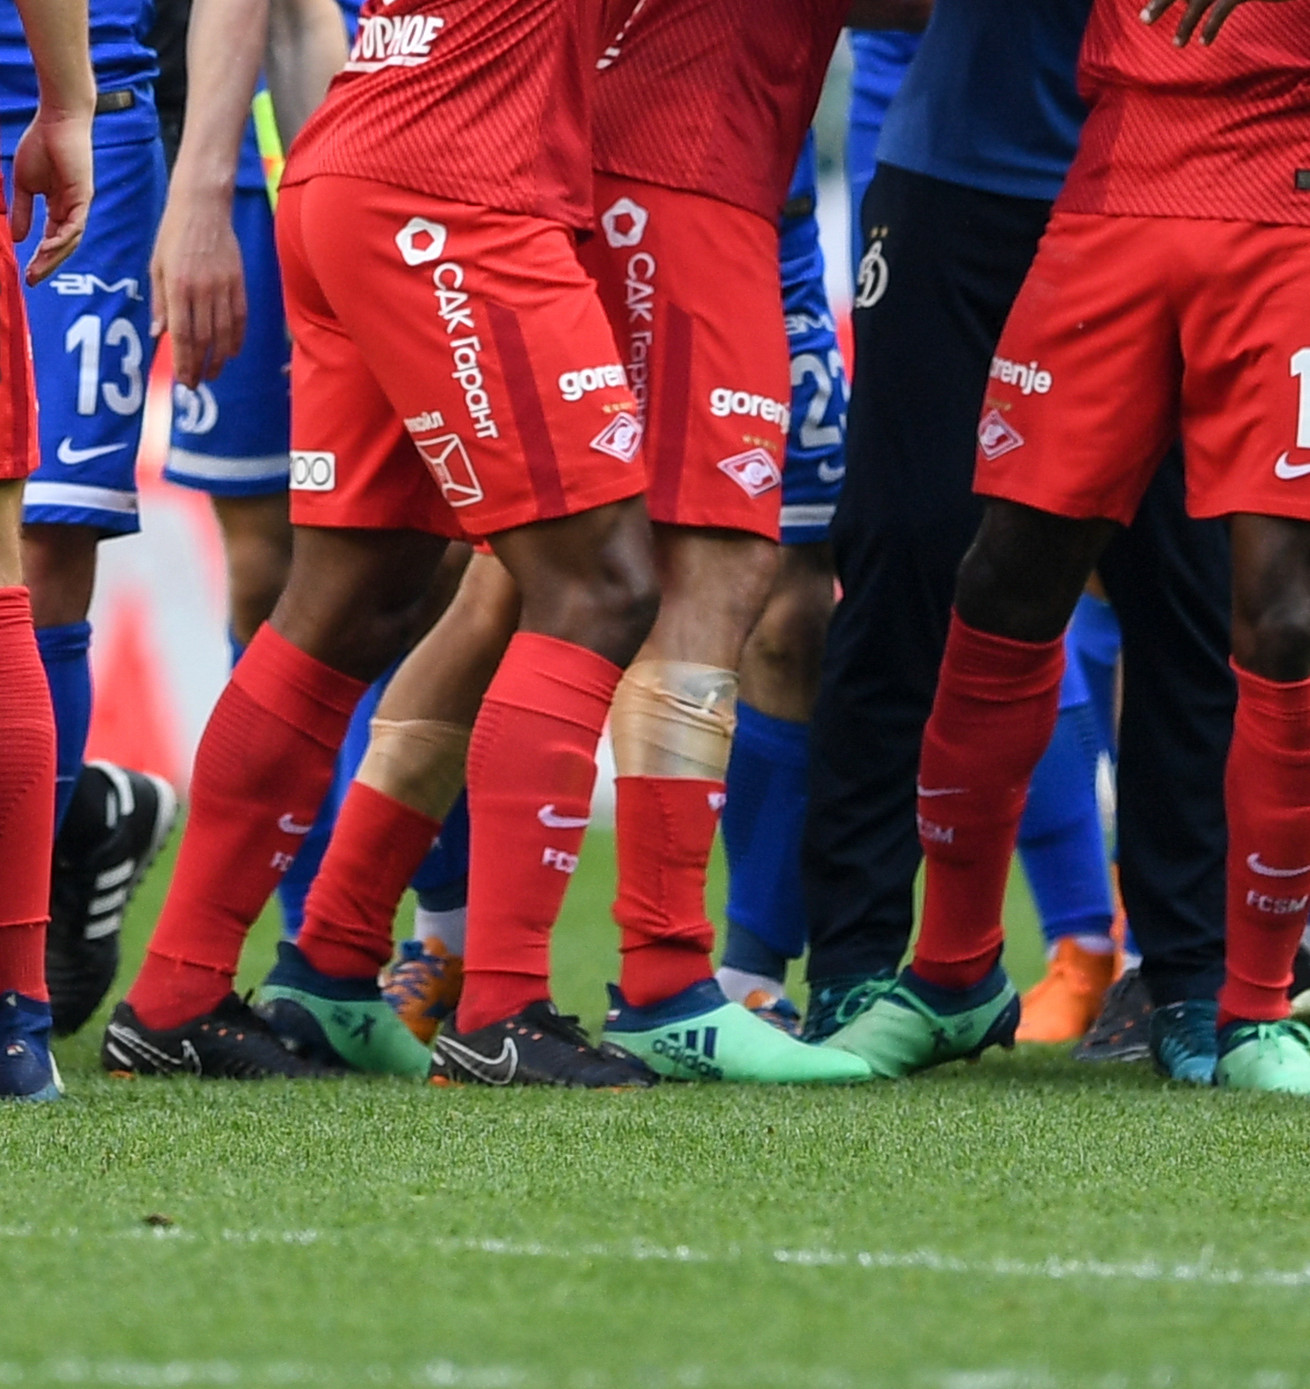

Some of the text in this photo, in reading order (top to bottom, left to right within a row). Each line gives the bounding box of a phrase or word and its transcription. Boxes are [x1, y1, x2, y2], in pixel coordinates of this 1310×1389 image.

[65, 313, 144, 416] 13
[449, 334, 500, 441] Гарант
[626, 329, 654, 431] Гаран
[542, 845, 579, 875] FCS
